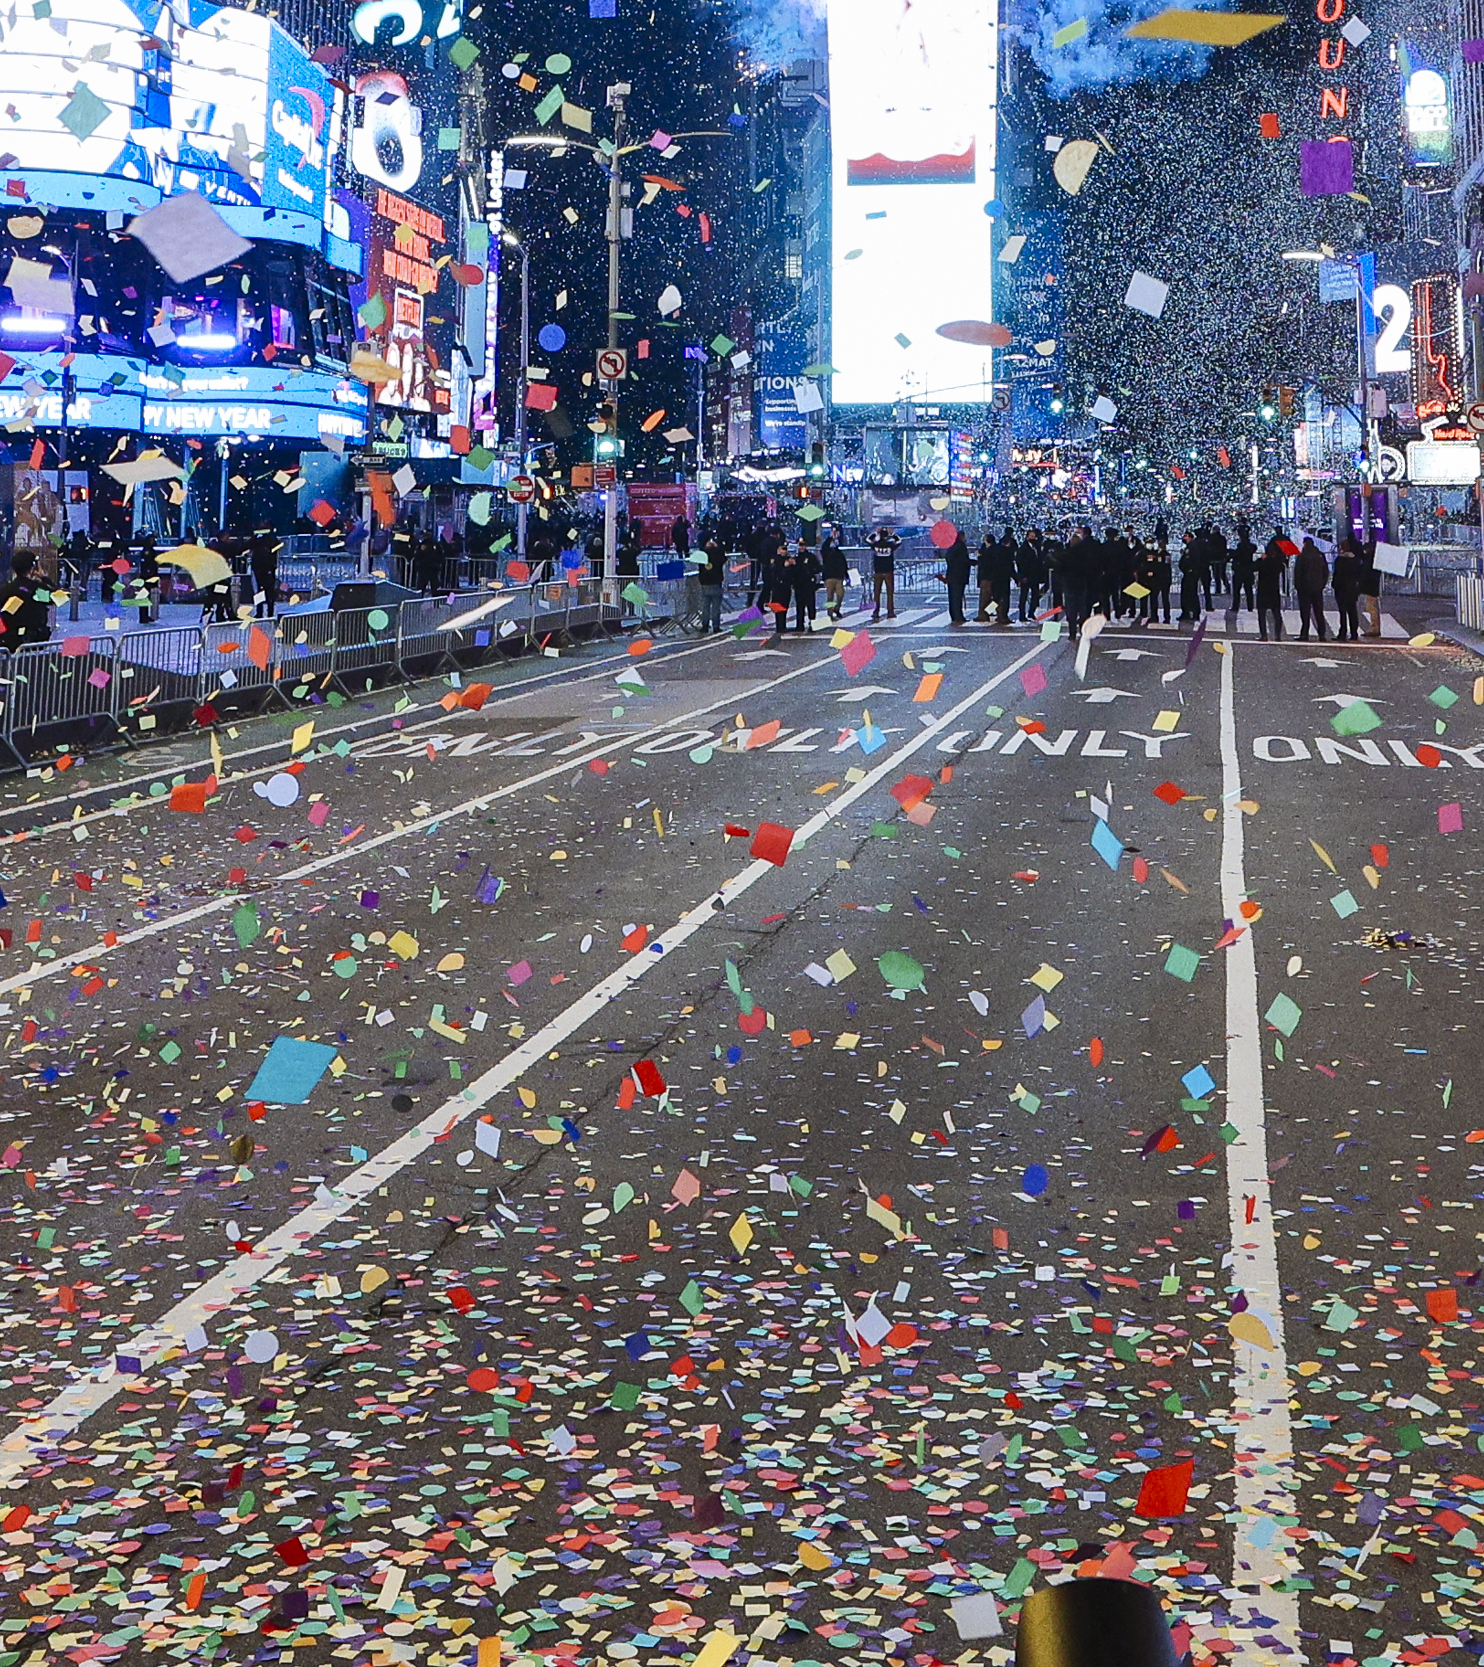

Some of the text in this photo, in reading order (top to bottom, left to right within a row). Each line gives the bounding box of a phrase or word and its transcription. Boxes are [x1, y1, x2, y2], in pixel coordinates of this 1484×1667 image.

[486, 150, 504, 210] Locker
[166, 407, 215, 428] NEW
[216, 408, 271, 428] YEAR
[936, 729, 1192, 758] ONLY
